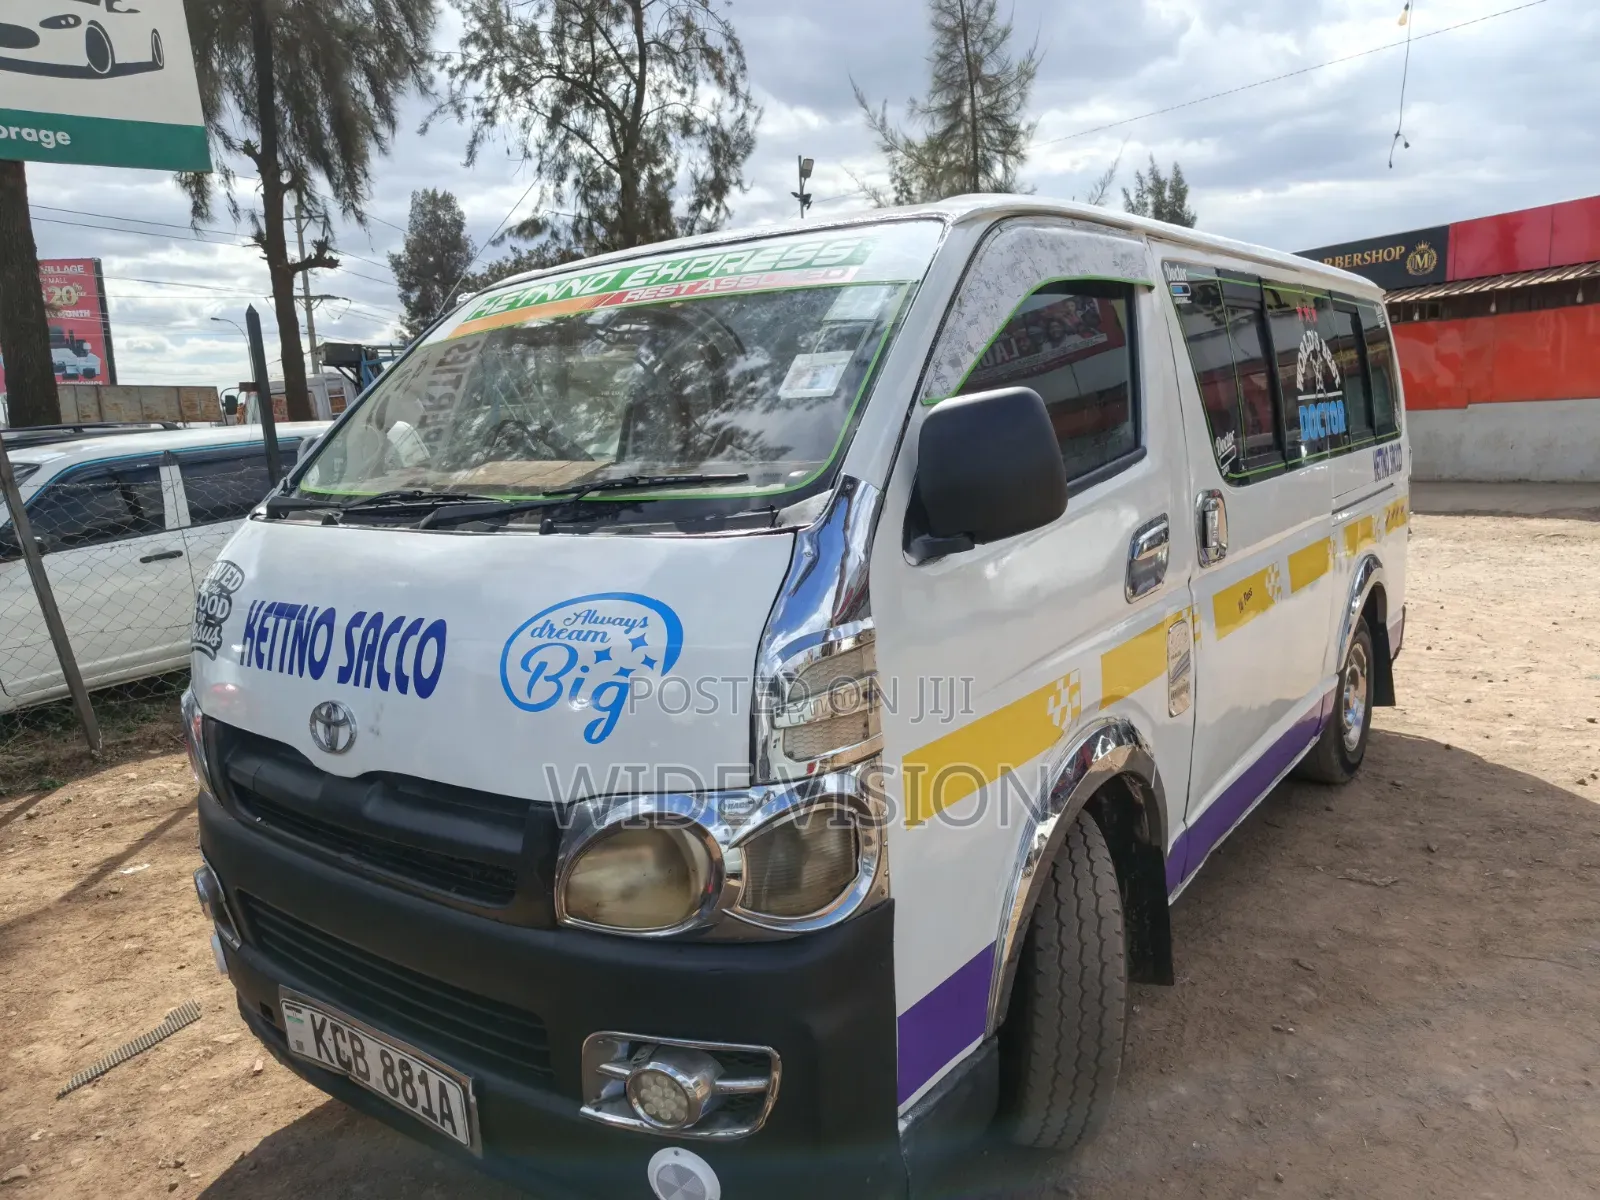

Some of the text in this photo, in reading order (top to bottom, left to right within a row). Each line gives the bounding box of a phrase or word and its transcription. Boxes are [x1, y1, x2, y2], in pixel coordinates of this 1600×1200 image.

[619, 240, 862, 288] EXPRESS
[1318, 245, 1406, 269] RBERSHOP
[694, 266, 847, 293] ASSUED
[1299, 400, 1346, 441] DOCTOR
[530, 619, 611, 644] dream
[563, 609, 649, 634] Always
[337, 611, 447, 699] SACCO
[520, 642, 632, 744] Big
[310, 1013, 458, 1136] KCB 881A
